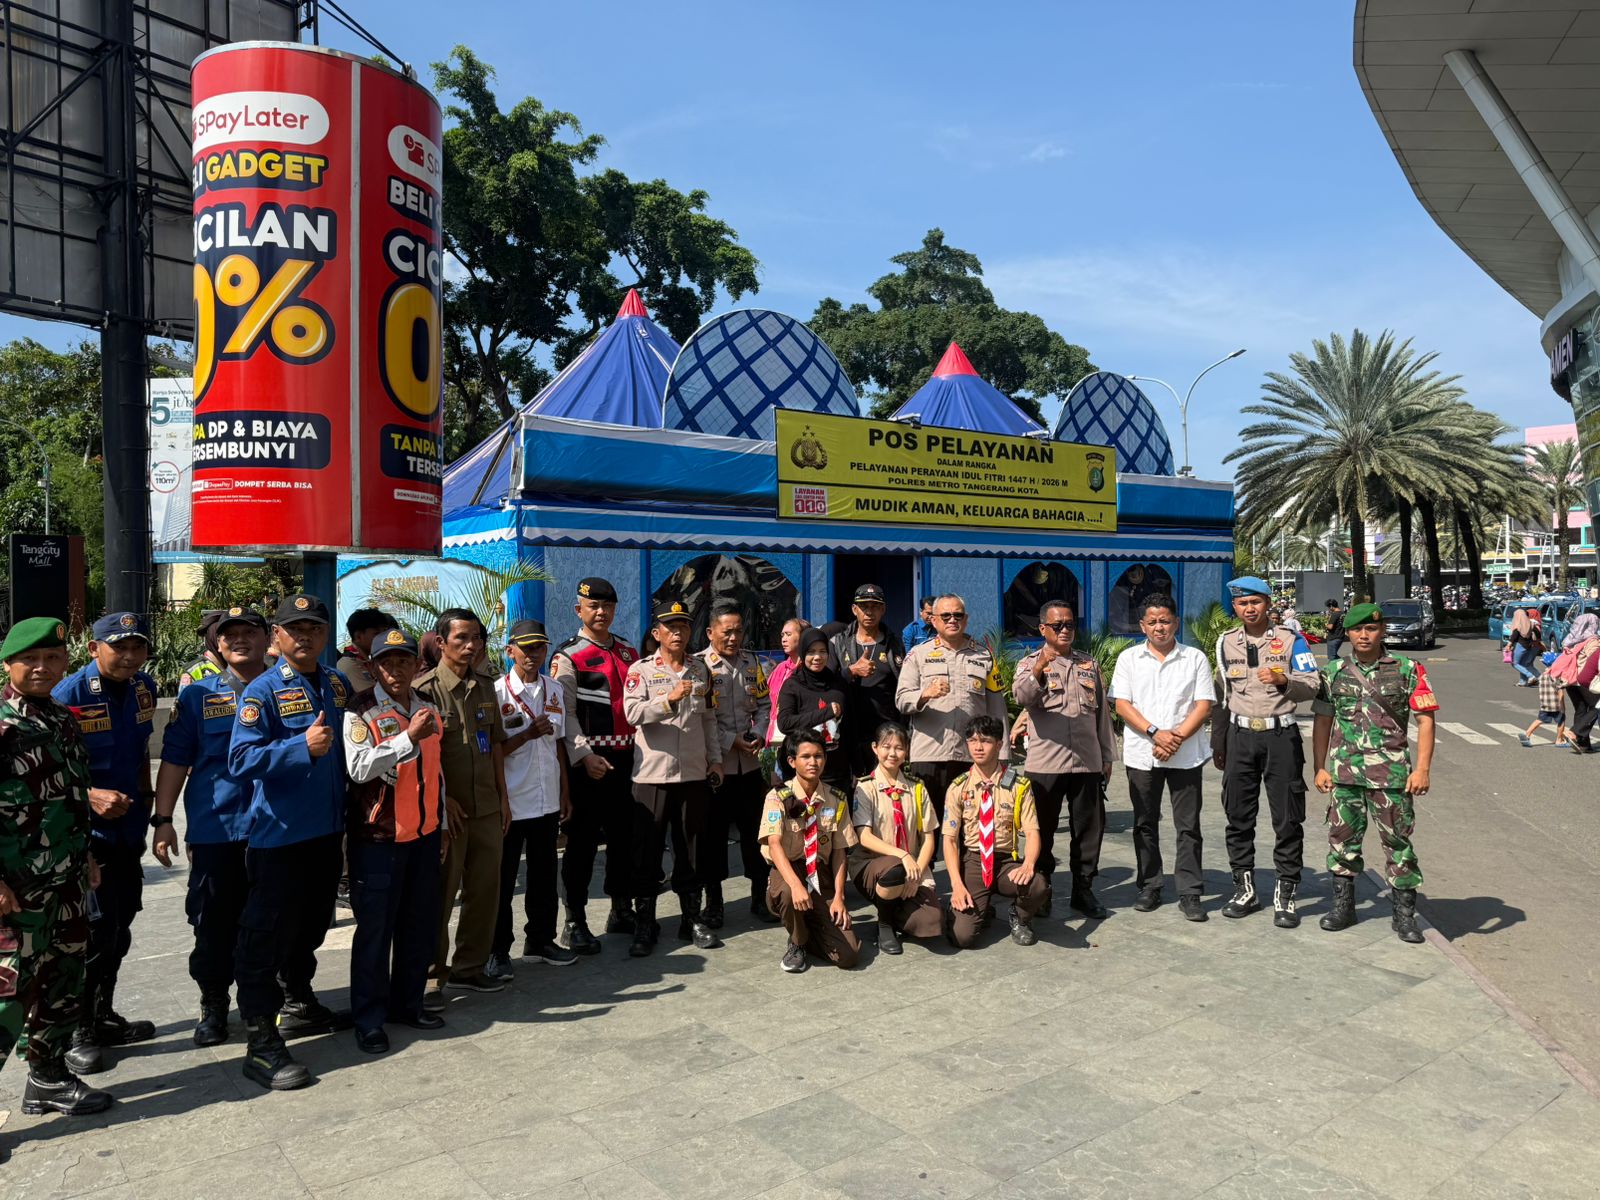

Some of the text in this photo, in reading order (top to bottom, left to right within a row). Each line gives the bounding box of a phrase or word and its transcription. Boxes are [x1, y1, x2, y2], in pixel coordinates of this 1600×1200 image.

[199, 105, 309, 136] SPayLater
[206, 152, 325, 184] GADGET
[390, 178, 433, 219] BELI
[151, 397, 170, 425] 5
[208, 421, 228, 438] DP
[233, 420, 245, 437] &
[252, 420, 318, 439] BIAYA
[390, 432, 437, 458] TANPA
[869, 428, 1053, 463] POS PELAYANAN
[850, 462, 908, 474] PELAYANAN
[911, 467, 959, 478] PERAYAAN
[961, 471, 982, 480] IDUL
[984, 473, 1006, 482] FITRI
[1009, 475, 1027, 483] 1447
[1042, 479, 1060, 487] 2026
[937, 458, 997, 470] DALAM RANGKA
[888, 477, 926, 487] POLRES
[928, 481, 960, 489] METRO
[963, 483, 1015, 493] TANGERANG
[795, 500, 826, 513] 110
[855, 498, 908, 513] MUDIK
[911, 502, 959, 518] AMAN,
[963, 505, 1029, 519] KELUARGA
[1032, 508, 1085, 523] BAHAGIA
[29, 556, 51, 567] Mall
